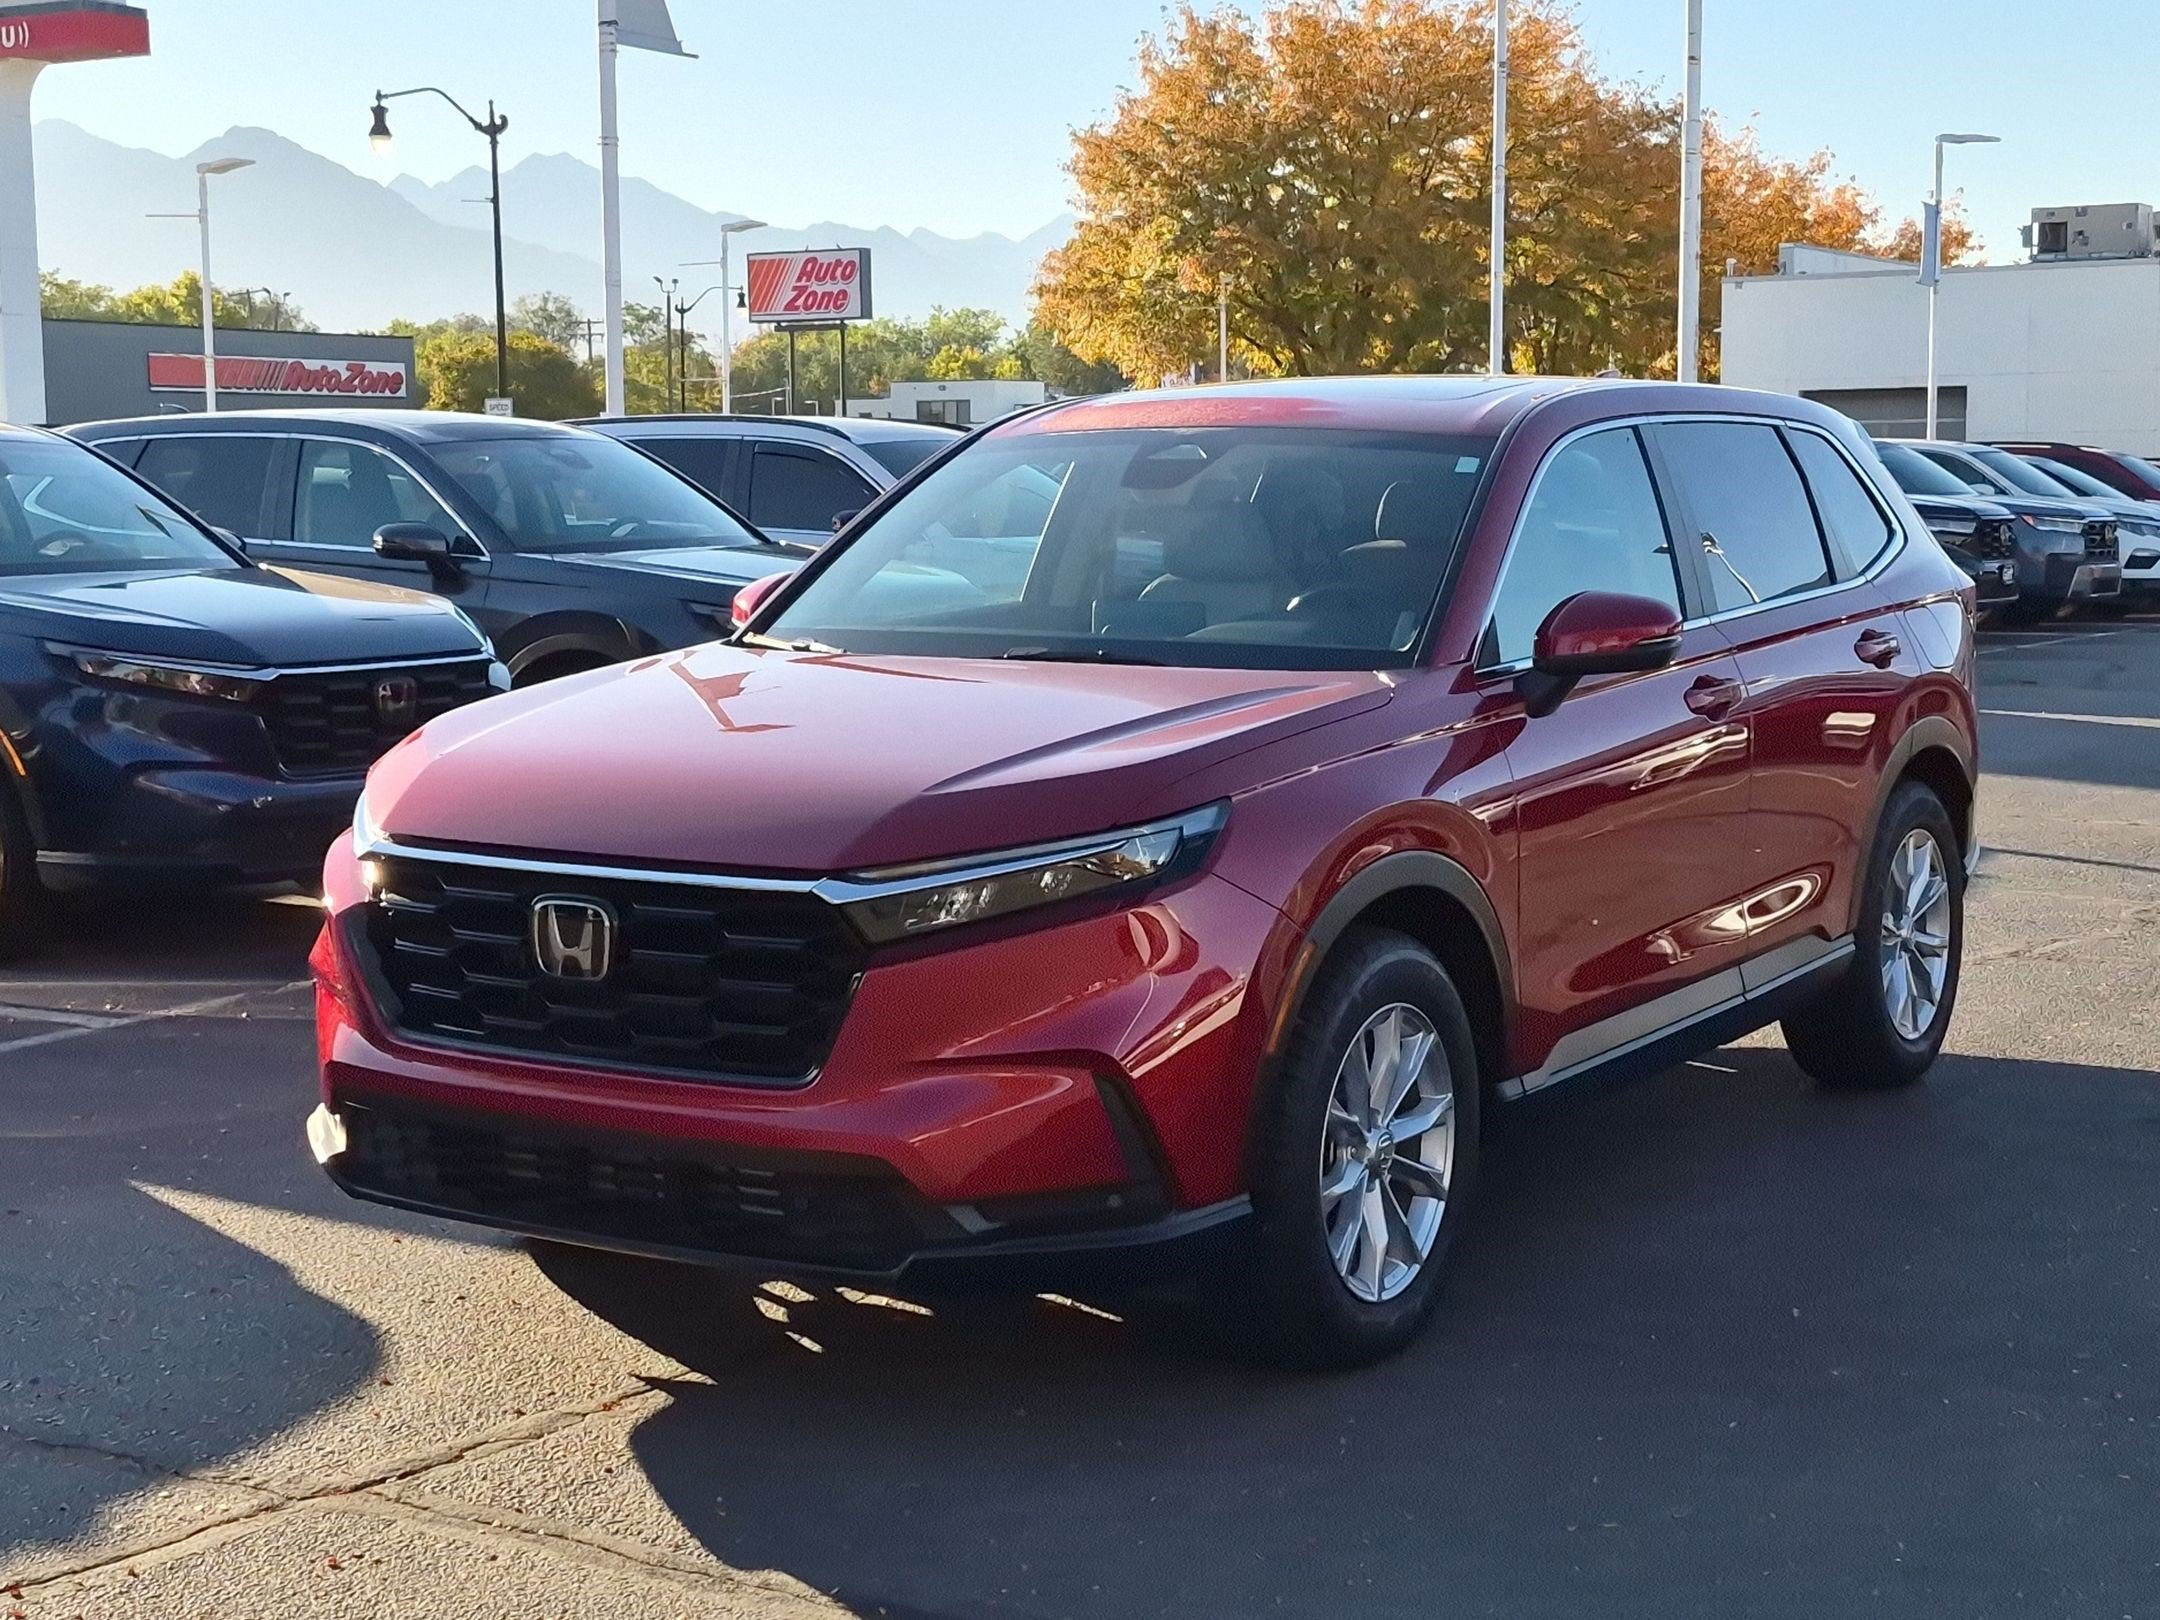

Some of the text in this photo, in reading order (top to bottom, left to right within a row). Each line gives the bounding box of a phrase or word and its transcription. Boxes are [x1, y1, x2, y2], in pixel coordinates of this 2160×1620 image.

[795, 256, 857, 283] Auto
[783, 285, 848, 313] Zone
[280, 360, 403, 394] AutoZone
